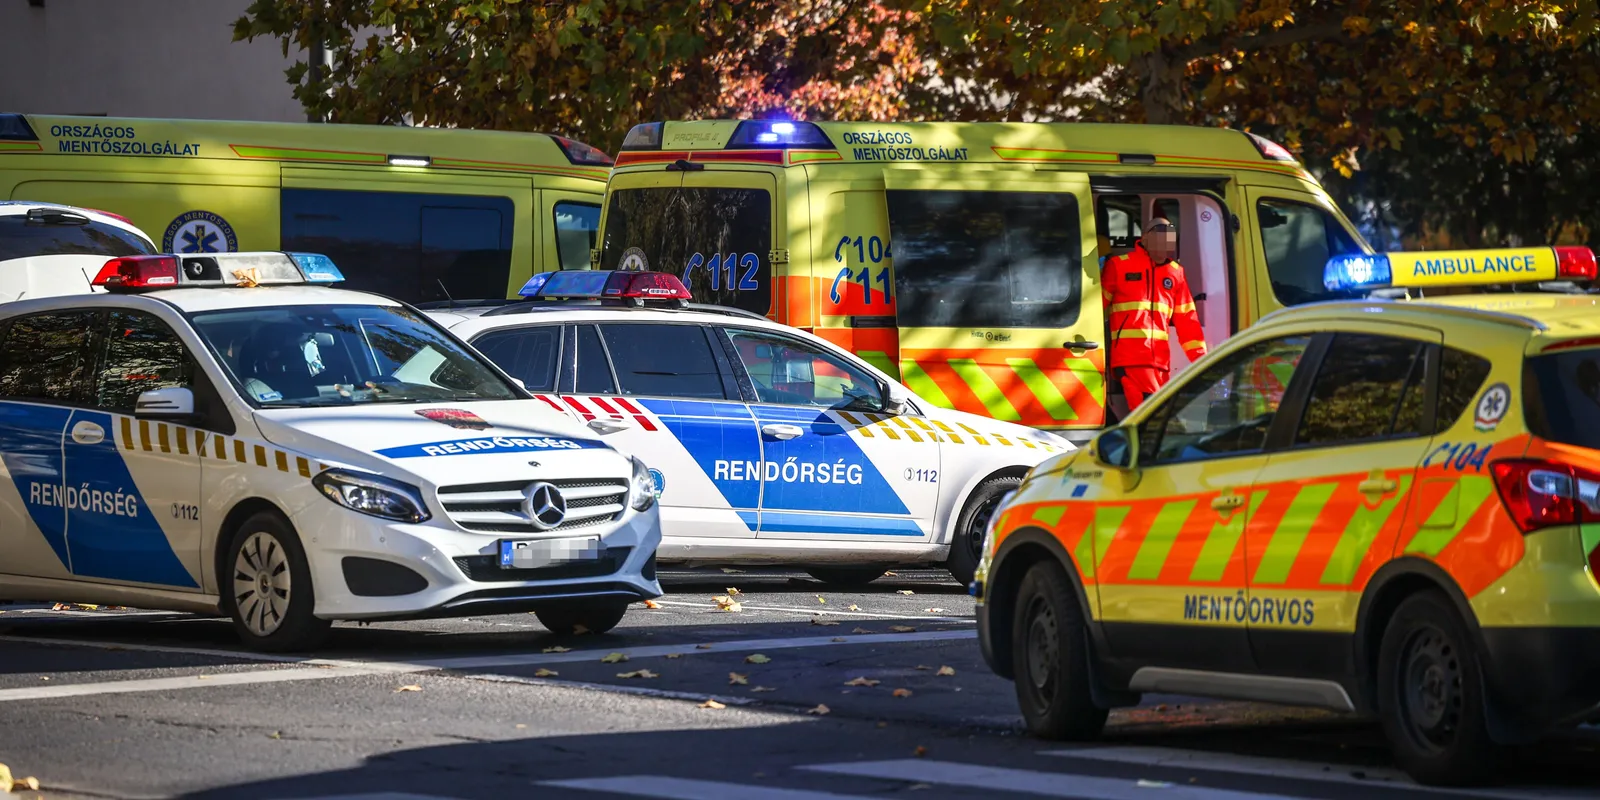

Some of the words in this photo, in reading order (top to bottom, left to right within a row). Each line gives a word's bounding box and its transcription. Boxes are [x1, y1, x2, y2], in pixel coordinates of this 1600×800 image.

[50, 124, 135, 138] ORSZÁGOS
[843, 130, 912, 145] ORSZÁGOS
[59, 139, 200, 155] MENTŐSZOLGÁLAT
[853, 145, 967, 161] MENTŐSZOLGÁLAT
[165, 219, 182, 253] SZÁGOS
[707, 252, 760, 291] 112
[1413, 255, 1536, 276] AMBULANCE
[856, 267, 890, 305] 11
[422, 436, 582, 456] RENDŐRSÉG
[1444, 442, 1494, 472] 104
[714, 456, 863, 485] RENDŐRSÉG
[916, 468, 937, 483] 112
[30, 481, 137, 517] RENDŐRSÉG
[181, 505, 199, 521] 112
[1184, 590, 1314, 625] MENTŐORVOS
